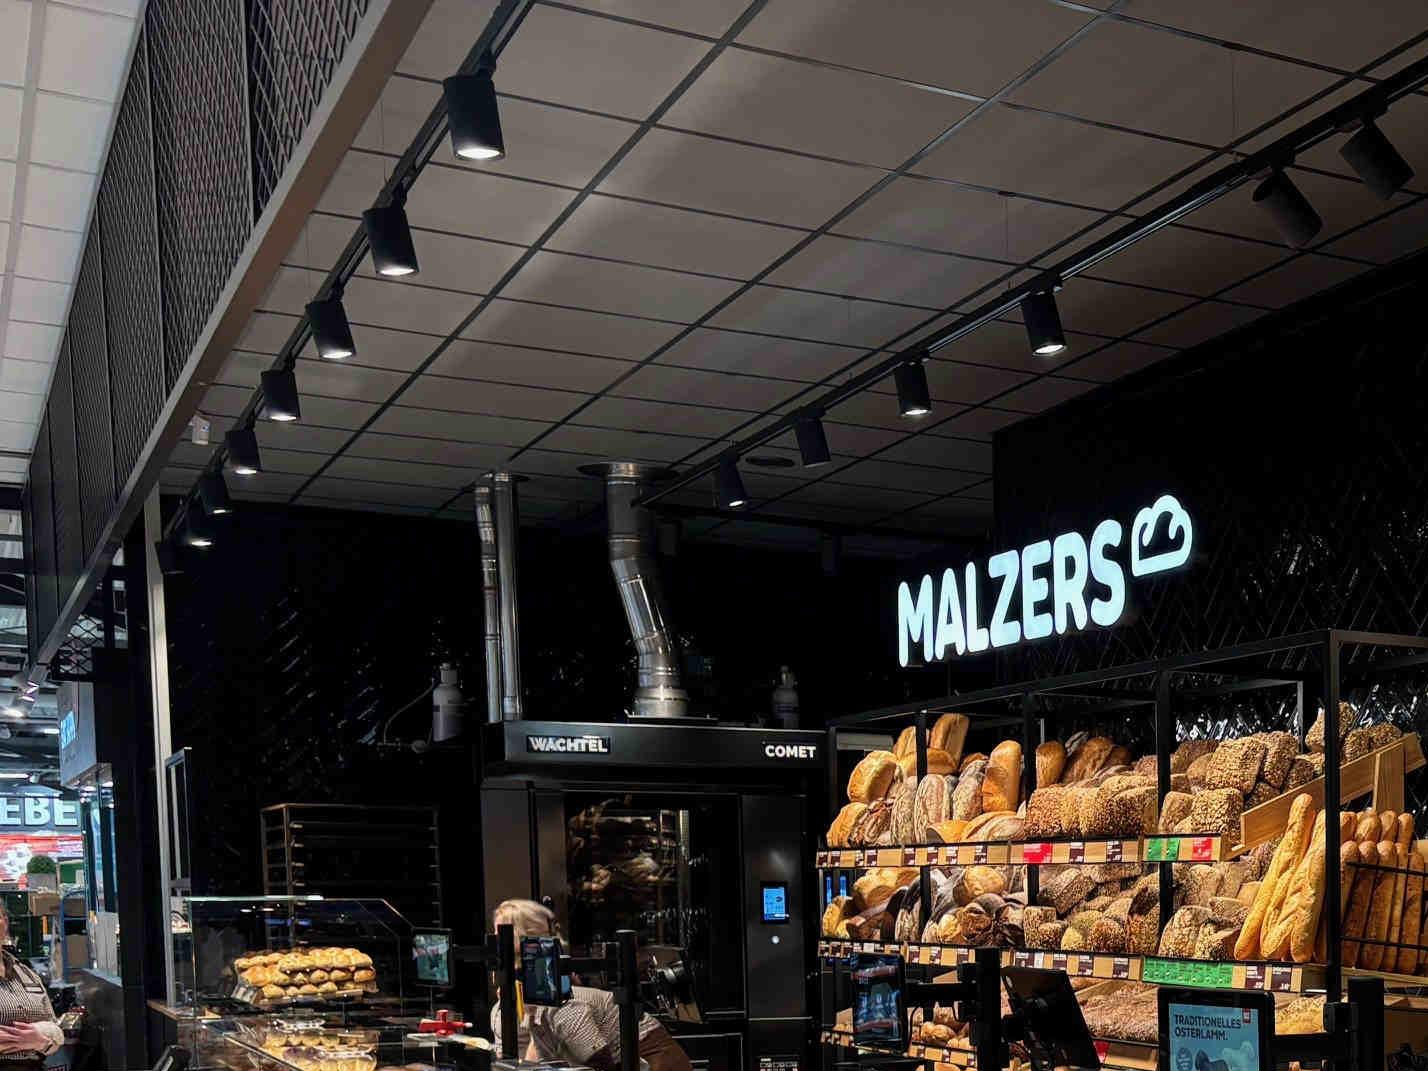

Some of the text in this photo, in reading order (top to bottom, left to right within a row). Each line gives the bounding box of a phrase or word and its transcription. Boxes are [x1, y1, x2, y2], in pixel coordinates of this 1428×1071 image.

[898, 520, 1125, 668] MALZERS
[529, 735, 608, 753] WACHTEL
[765, 745, 816, 759] COMET
[1174, 1014, 1241, 1029] TRADITIONELLES
